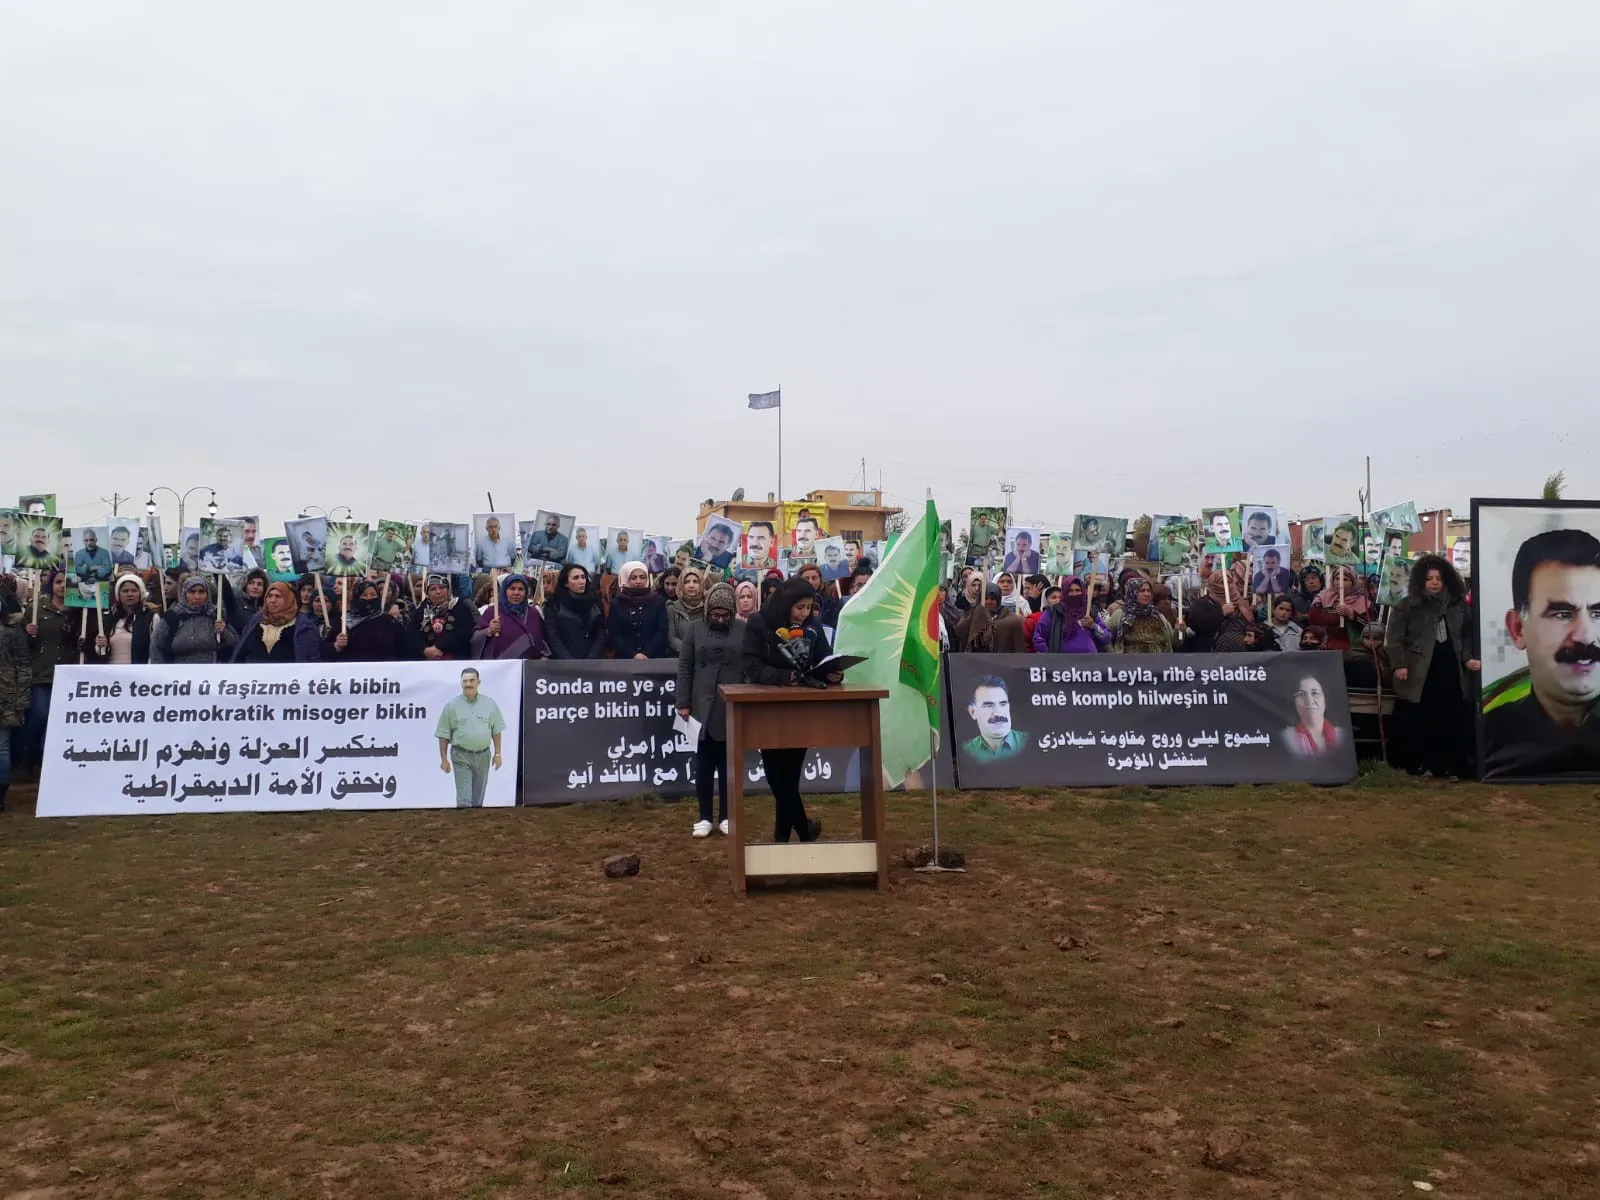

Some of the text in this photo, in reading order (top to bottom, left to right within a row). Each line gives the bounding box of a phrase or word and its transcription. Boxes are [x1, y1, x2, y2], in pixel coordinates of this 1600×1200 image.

[1029, 665, 1268, 686] Bi sekna Leyla, rihê şeladizê
[129, 679, 192, 698] tecrîd
[198, 679, 211, 697] û
[218, 678, 301, 700] faşîzmê
[308, 678, 343, 696] têk
[349, 677, 401, 695] bibin
[535, 677, 594, 695] Sonda
[599, 680, 628, 694] me
[632, 679, 654, 697] ye
[1031, 689, 1228, 710] emê komplo hilweşîn in
[65, 702, 427, 725] netewa demokratîk misoger bikin
[535, 705, 589, 724] parçe
[594, 701, 640, 719] bikin
[645, 700, 662, 717] bi
[1100, 729, 1146, 749] مقاومة
[1151, 732, 1183, 749] وروح
[1187, 729, 1220, 749] ليلى
[62, 734, 399, 769] سنكسر العزلة ونهزم الفاشية
[1158, 751, 1208, 770] سنفشل
[599, 762, 647, 783] القائد
[804, 751, 832, 780] وأن
[121, 766, 397, 804] ونحقق الأمة الديمقراطية
[652, 767, 679, 786] مع
